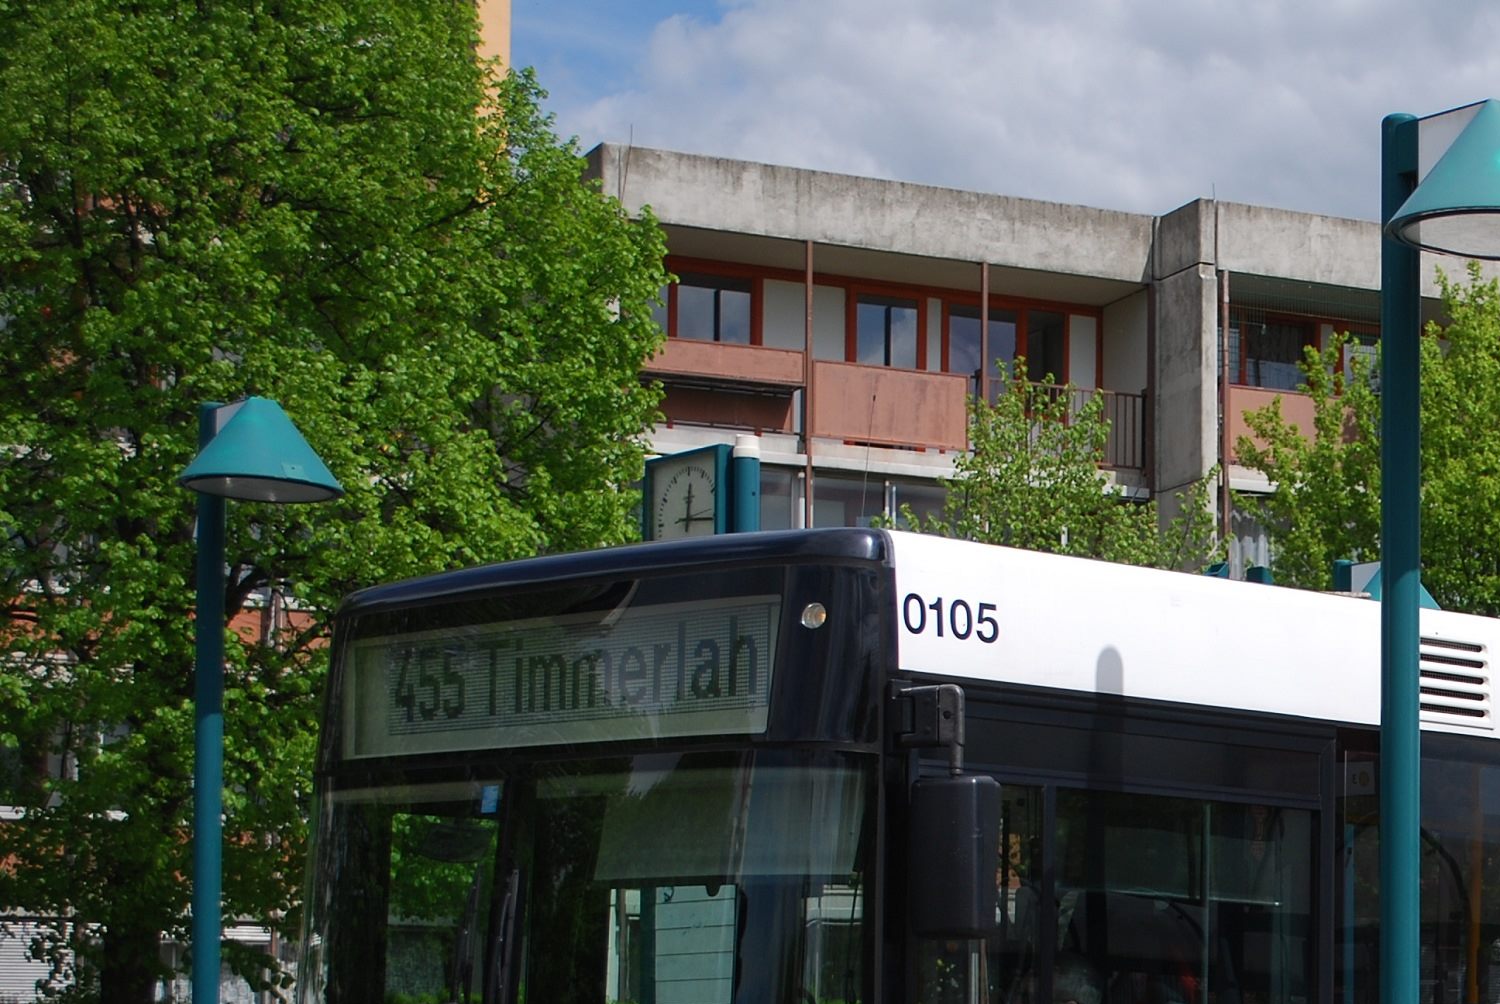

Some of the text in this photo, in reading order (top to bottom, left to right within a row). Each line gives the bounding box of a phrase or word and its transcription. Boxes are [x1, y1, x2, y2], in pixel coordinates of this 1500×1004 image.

[903, 593, 999, 644] 0105
[394, 615, 758, 722] 455 Timmerlah
